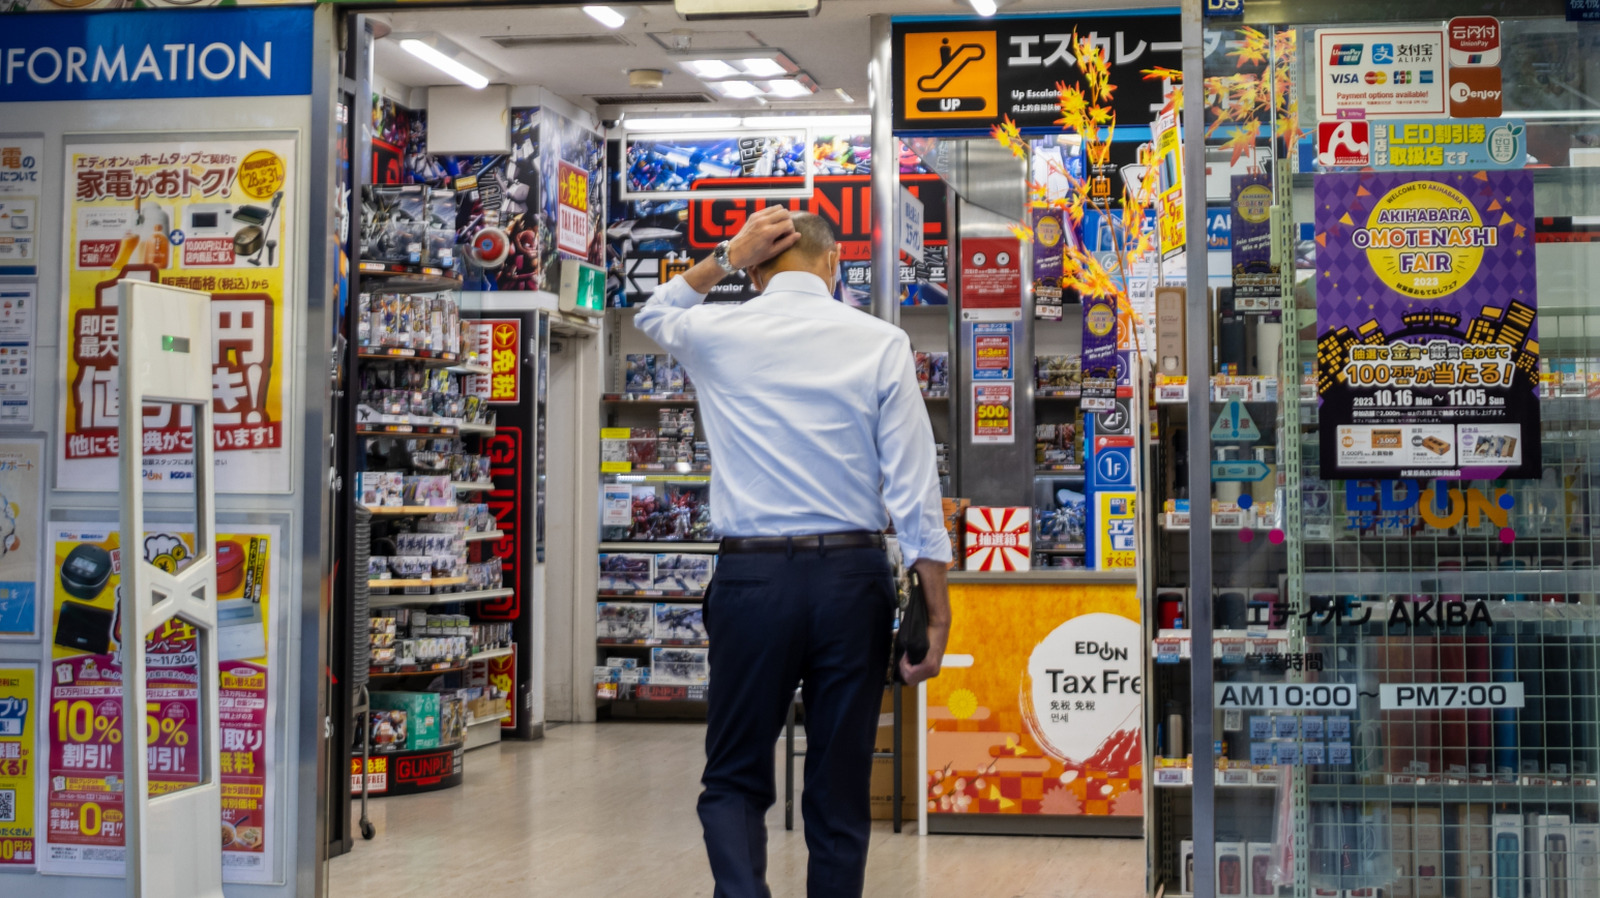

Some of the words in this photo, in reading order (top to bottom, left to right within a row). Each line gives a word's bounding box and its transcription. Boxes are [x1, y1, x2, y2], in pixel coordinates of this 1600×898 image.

[1452, 25, 1496, 40] 云闪付
[1332, 48, 1362, 57] UnionPay
[1397, 43, 1433, 56] 支付宝
[0, 41, 272, 84] FORMATION
[1331, 73, 1360, 84] VISA
[1394, 71, 1412, 84] JCB
[940, 98, 961, 111] UP
[1012, 89, 1025, 101] Up
[1337, 91, 1367, 101] Payment
[1369, 91, 1394, 101] options
[1395, 91, 1429, 99] available!
[1389, 123, 1486, 144] LED割引券
[1374, 124, 1387, 166] 当店は
[1389, 146, 1469, 166] 取扱店です
[76, 166, 236, 200] 家電がおトク!
[1387, 184, 1417, 203] WELCOME
[1428, 184, 1463, 204] AKIHABARA
[1378, 208, 1471, 223] AKIHABARA
[80, 243, 116, 251] ホームタップ
[1353, 226, 1498, 248] OMOTENASHI
[1242, 244, 1253, 252] Win
[1400, 252, 1453, 272] FAIR
[1413, 277, 1439, 286] 2023
[492, 348, 516, 398] 免税
[1346, 362, 1513, 386] 100万円が当たる!
[1415, 395, 1432, 406] Mon
[1448, 389, 1486, 406] 11.05
[1489, 395, 1505, 405] Sun
[1103, 409, 1123, 426] 2F
[1105, 457, 1121, 477] 1F
[484, 434, 515, 612] GUNP
[1347, 515, 1415, 529] エディオン
[979, 531, 1017, 546] 抽選箱
[1247, 601, 1372, 627] エディオン
[1388, 600, 1494, 627] AKIBA
[1075, 641, 1128, 661] EDION
[1246, 652, 1323, 671] 営業時間
[1045, 669, 1097, 694] Tax
[1050, 700, 1071, 711] 免税
[1220, 685, 1352, 706] AM10:00
[1396, 685, 1507, 706] PM7:00
[53, 700, 122, 744] 10%
[63, 743, 113, 769] 割引!
[399, 754, 453, 778] GUNPLA
[50, 819, 79, 830] 手数料
[80, 802, 102, 836] 0
